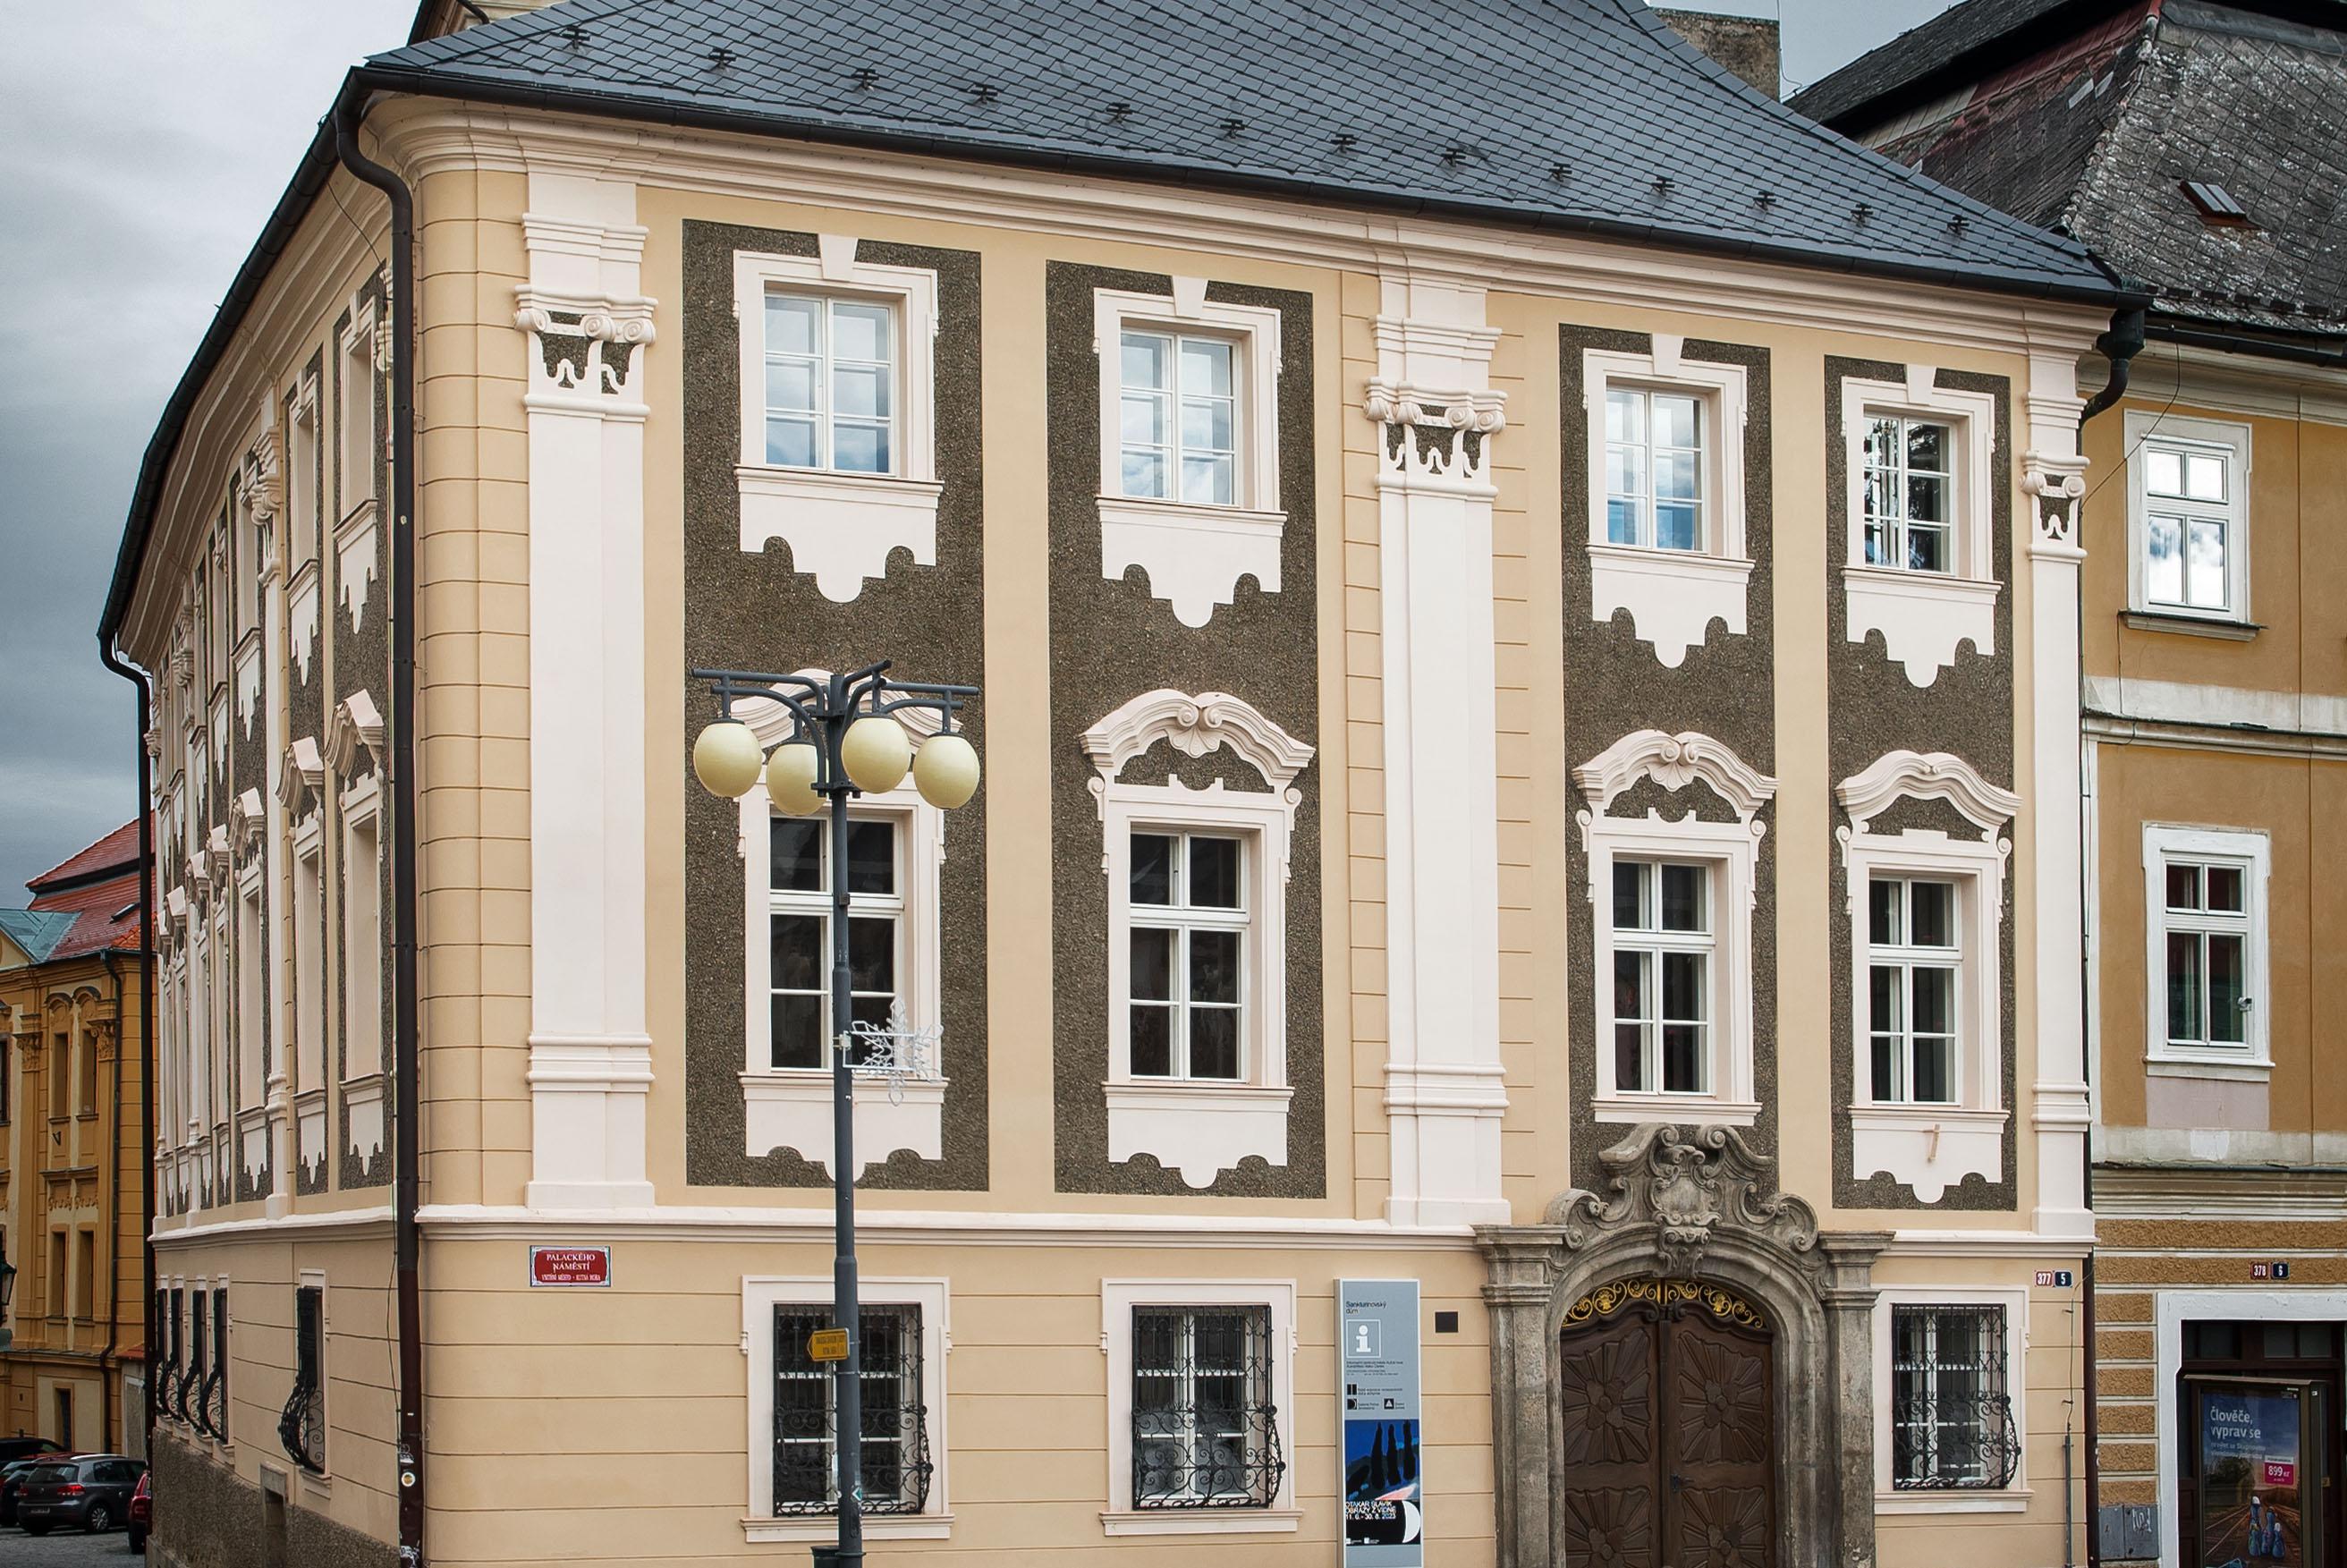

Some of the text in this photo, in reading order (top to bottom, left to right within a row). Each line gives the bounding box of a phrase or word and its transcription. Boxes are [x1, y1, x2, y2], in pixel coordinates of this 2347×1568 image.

[547, 1252, 596, 1261] PALACKÉHO
[553, 1261, 590, 1273] NÁMĚSTÍ
[2254, 1265, 2267, 1276] 378
[2038, 1273, 2051, 1285] 377
[2061, 1273, 2066, 1285] 5
[2210, 1406, 2253, 1425] Člověče,
[2211, 1426, 2261, 1439] vyprav se
[2268, 1465, 2283, 1477] 899
